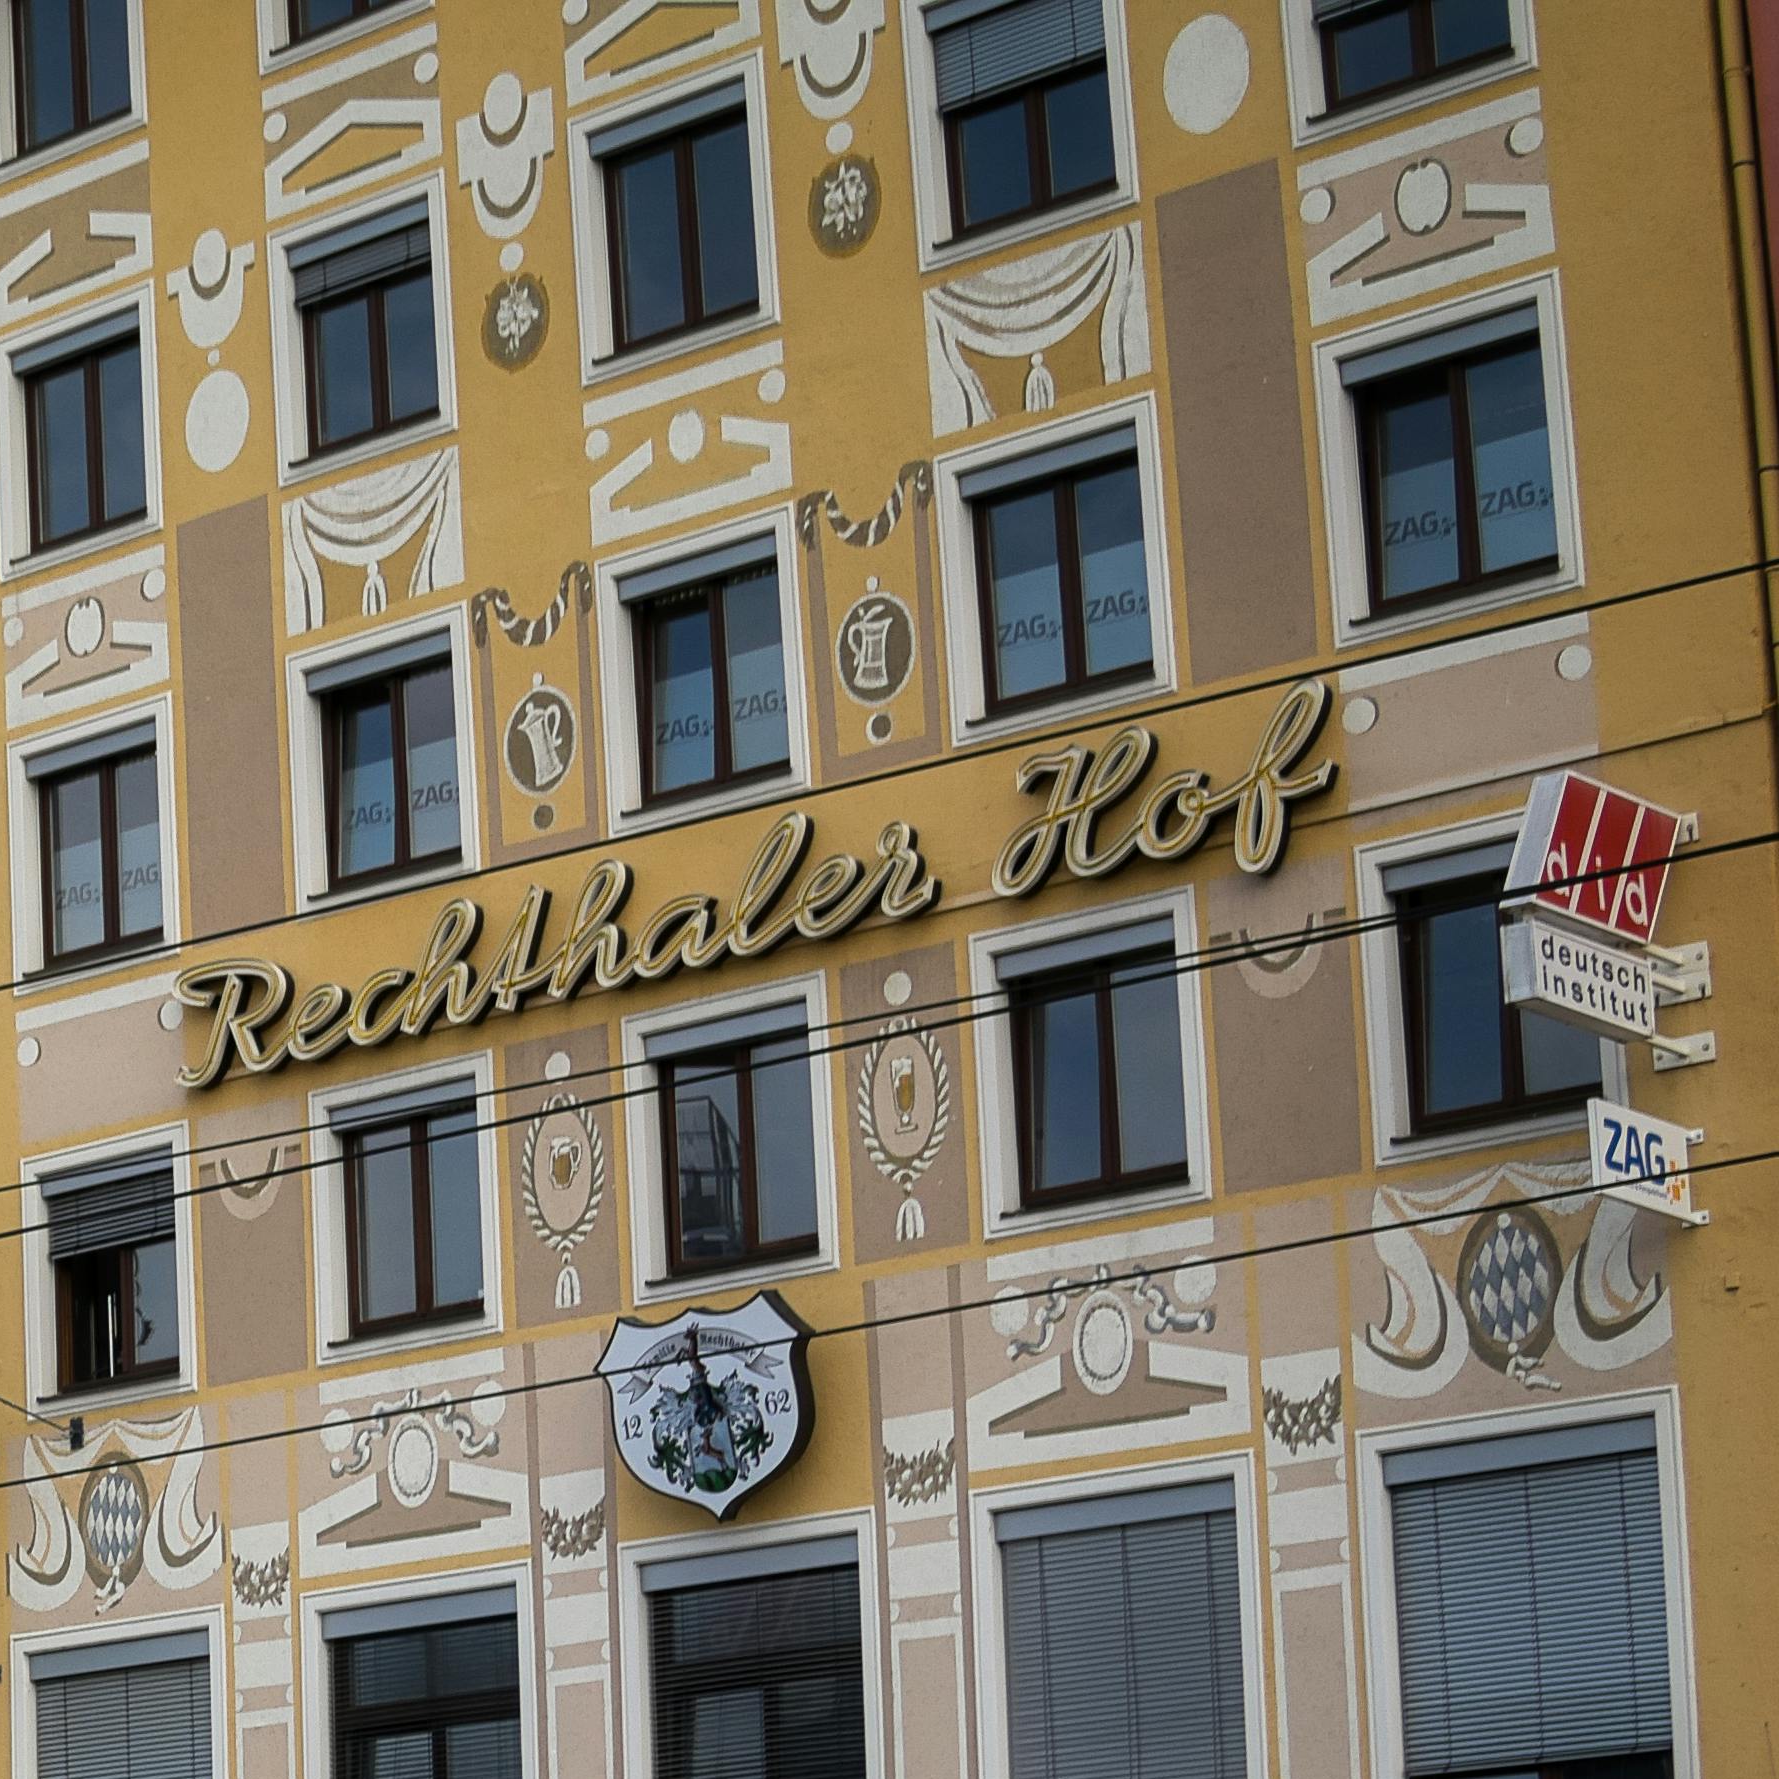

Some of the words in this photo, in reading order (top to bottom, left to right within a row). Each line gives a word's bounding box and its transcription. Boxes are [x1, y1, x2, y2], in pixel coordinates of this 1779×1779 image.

[1480, 480, 1535, 517] ZAG
[1385, 511, 1437, 546] ZAG
[1086, 589, 1135, 623] ZAG
[999, 614, 1046, 648] ZAG
[734, 689, 777, 722] ZAG
[656, 714, 699, 745] ZAG
[412, 782, 453, 811] ZAG
[345, 801, 382, 829] ZAG
[123, 863, 159, 892] ZAG
[172, 811, 940, 1088] Rechthaler
[993, 678, 1338, 901] Hof
[1548, 842, 1649, 928] did
[1541, 934, 1648, 994] deutsch
[1543, 971, 1650, 1027] institut
[1603, 1118, 1666, 1186] ZAG
[621, 1414, 644, 1441] 12
[764, 1388, 792, 1416] 62
